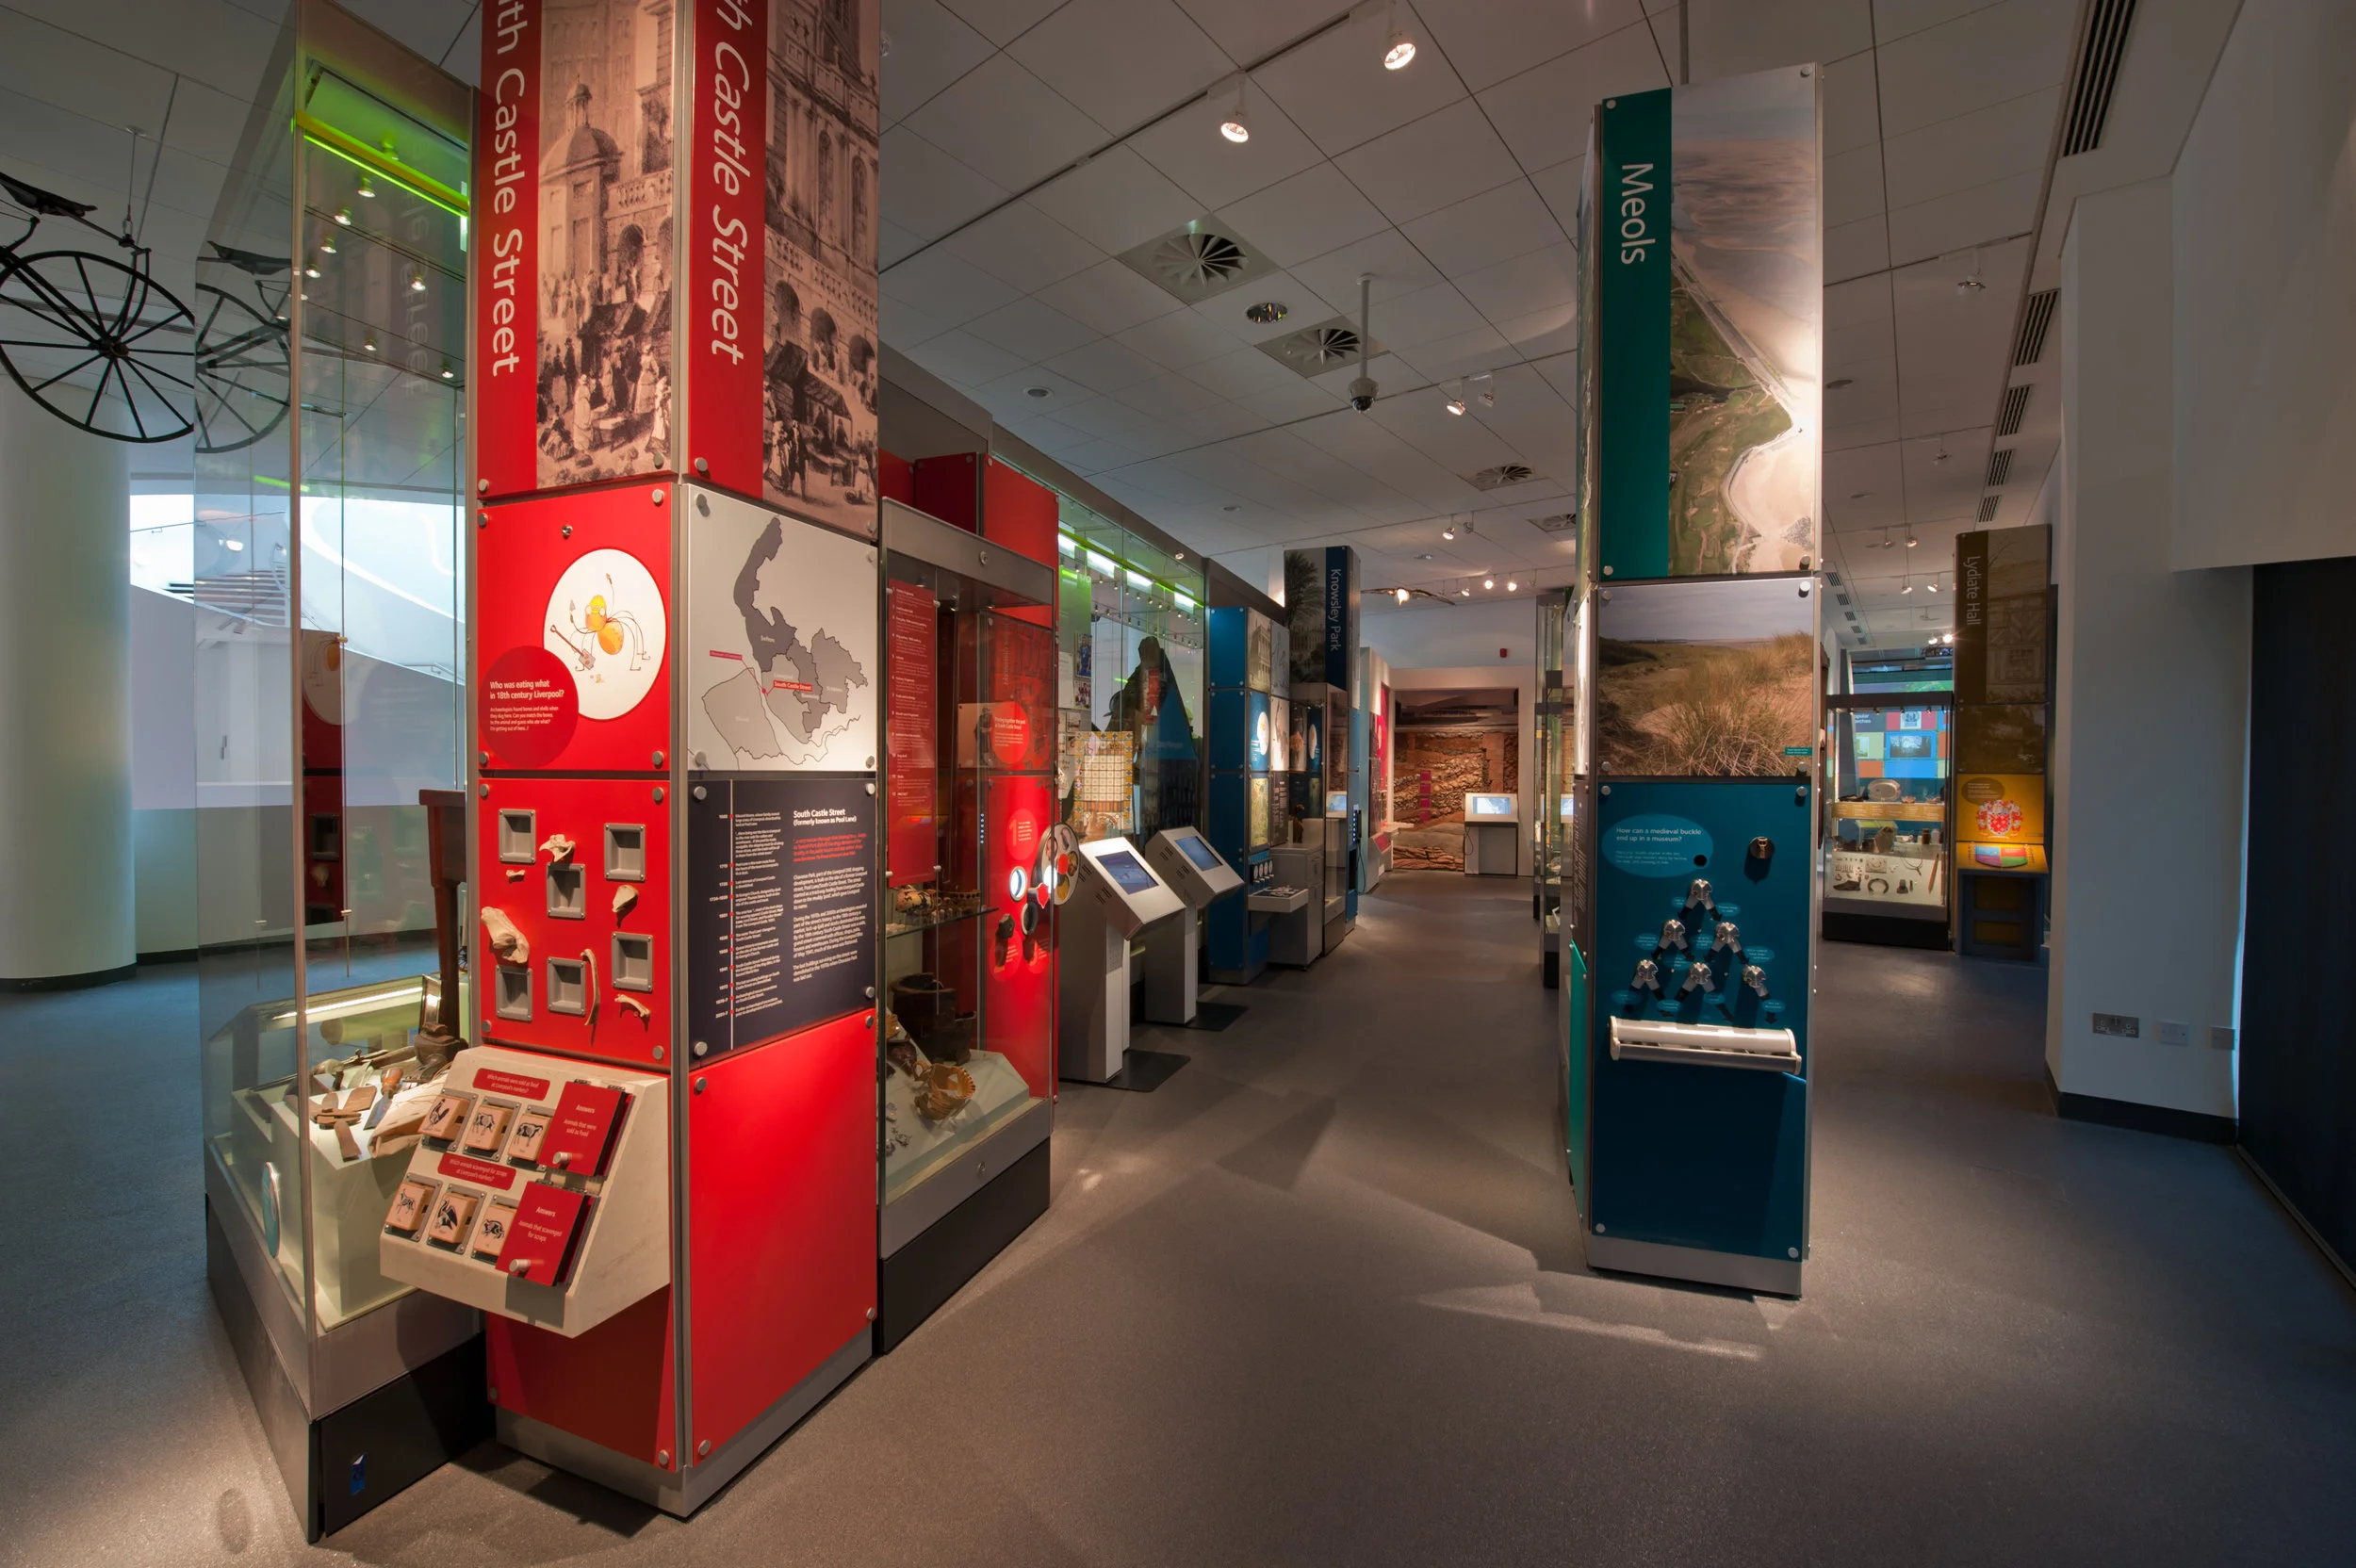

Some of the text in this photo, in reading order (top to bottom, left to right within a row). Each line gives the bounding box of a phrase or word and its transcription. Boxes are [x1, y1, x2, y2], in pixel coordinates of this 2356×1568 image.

[713, 41, 750, 195] Castle
[493, 0, 528, 376] th Castle Street
[1621, 163, 1656, 265] Meols
[712, 205, 747, 365] Street
[1963, 556, 1982, 625] Lydiate Hall
[1328, 569, 1342, 651] Knowsley Park
[490, 681, 503, 689] Who
[516, 680, 533, 690] eating
[497, 691, 510, 699] 18th
[511, 692, 532, 700] century
[534, 689, 564, 699] Liverpool?
[794, 810, 810, 818] South
[811, 809, 828, 817] Castle
[1009, 819, 1016, 846] 1
[576, 1104, 595, 1114] Answers
[564, 1119, 578, 1127] Animals
[536, 1207, 556, 1217] Answers
[519, 1220, 533, 1230] Animals
[541, 1226, 562, 1237] scavenged
